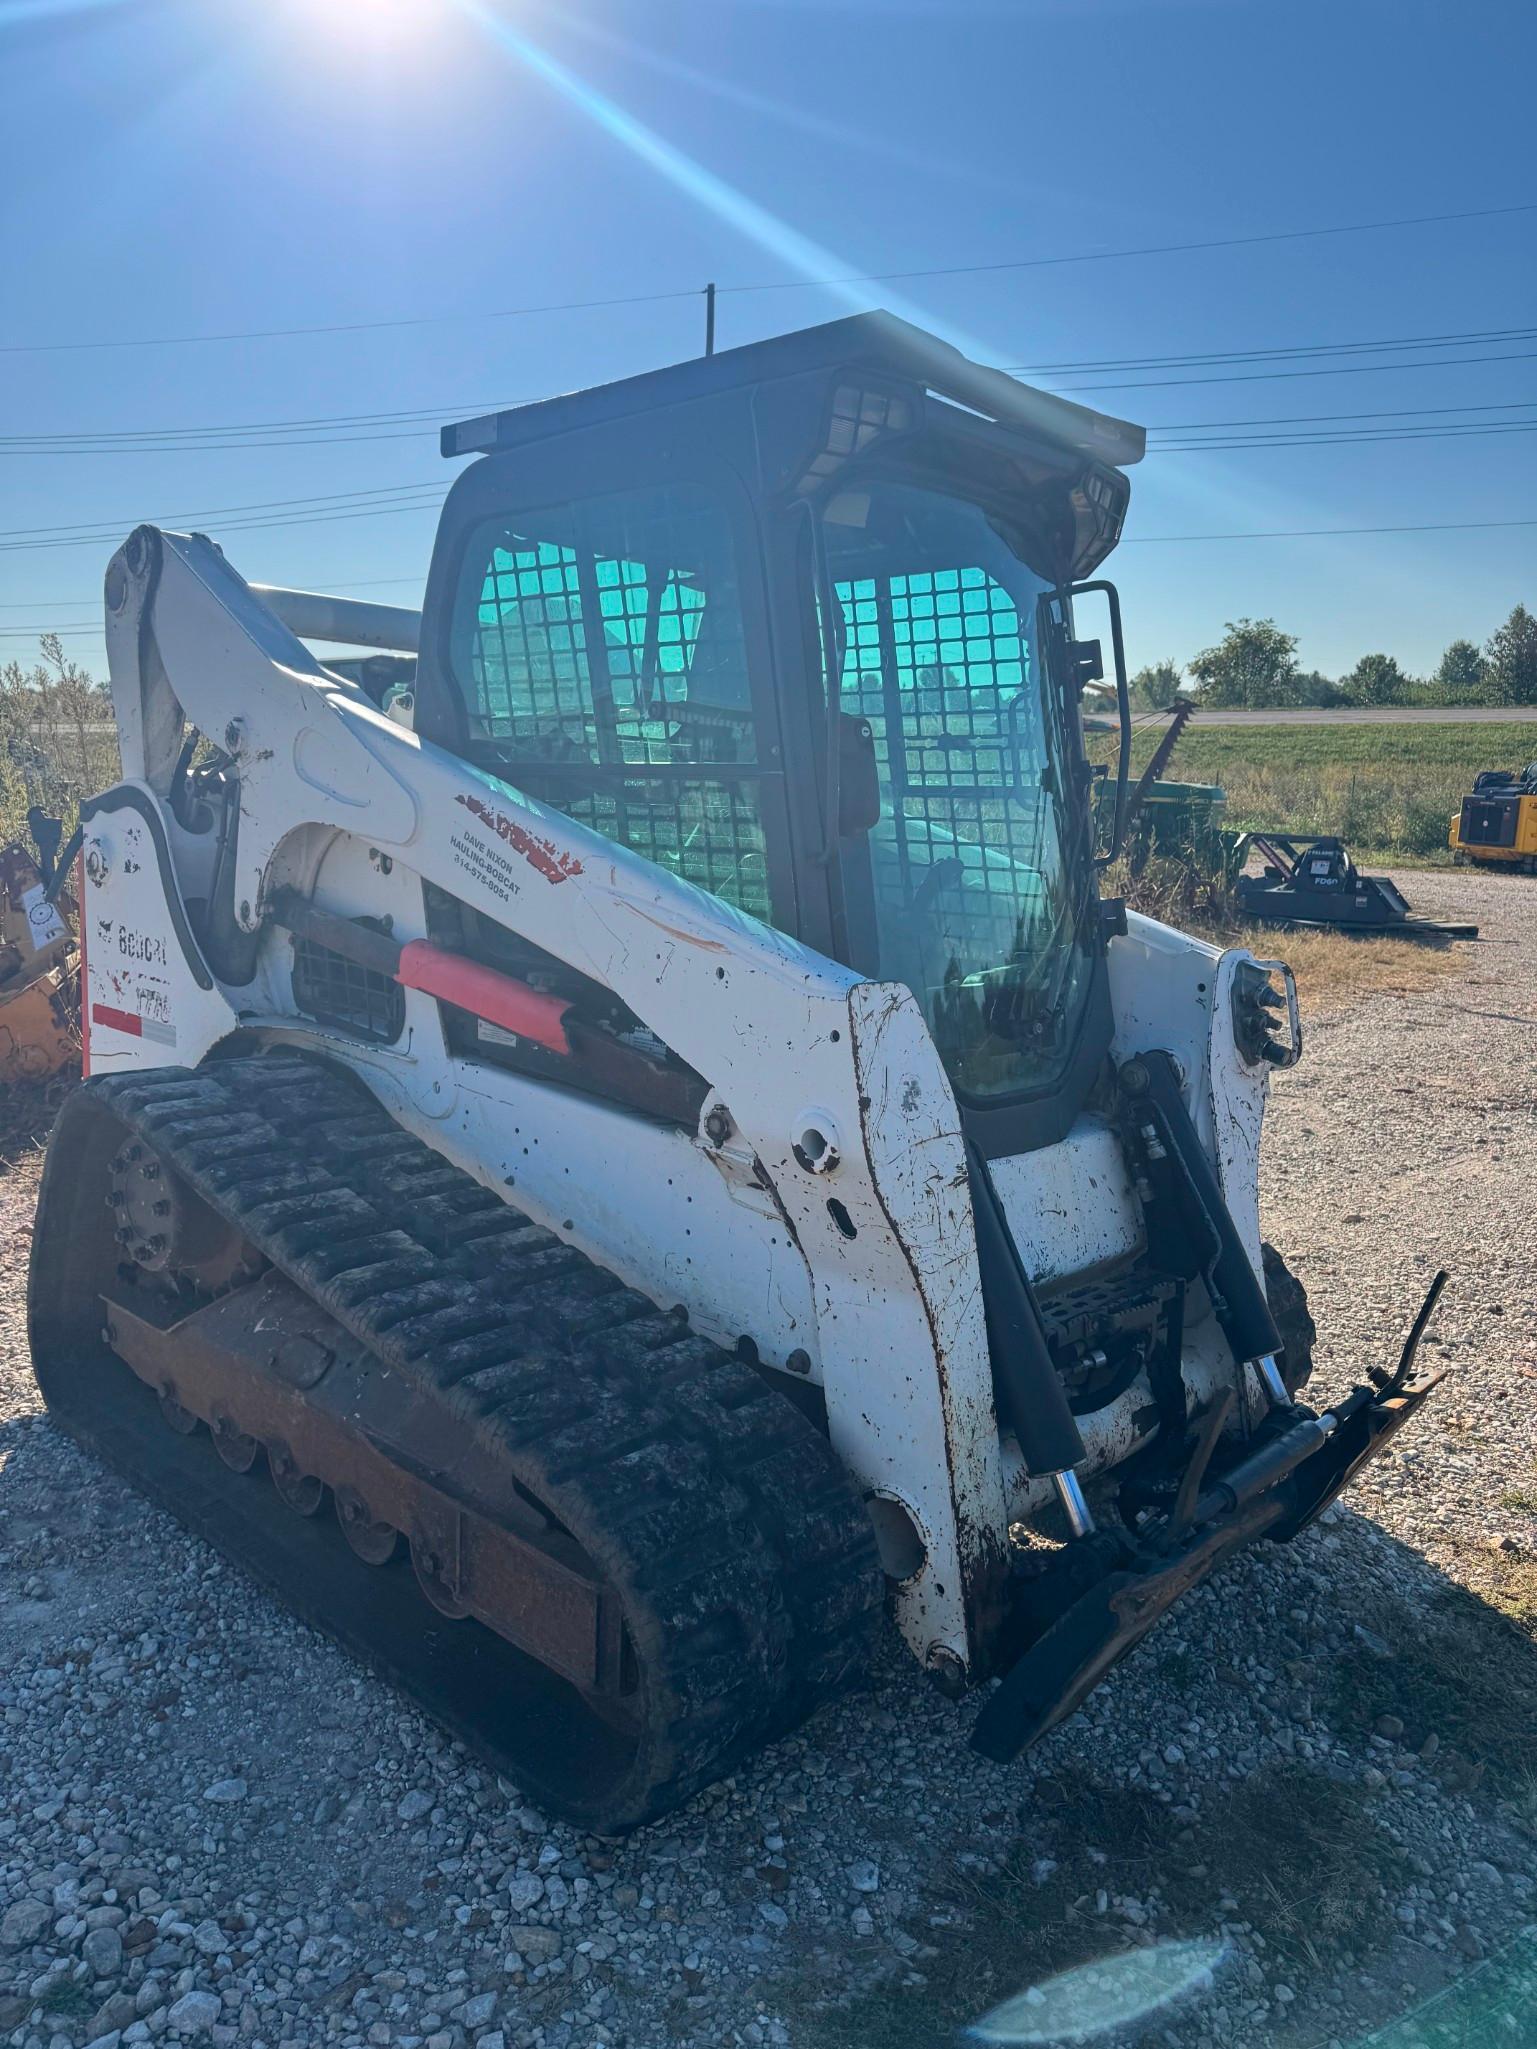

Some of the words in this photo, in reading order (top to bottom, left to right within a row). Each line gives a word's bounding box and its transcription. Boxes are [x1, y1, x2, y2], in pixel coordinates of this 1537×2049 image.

[450, 835, 521, 895] HAULING-BOBCAT
[463, 831, 486, 853] DAVE
[486, 848, 513, 875] NIXON
